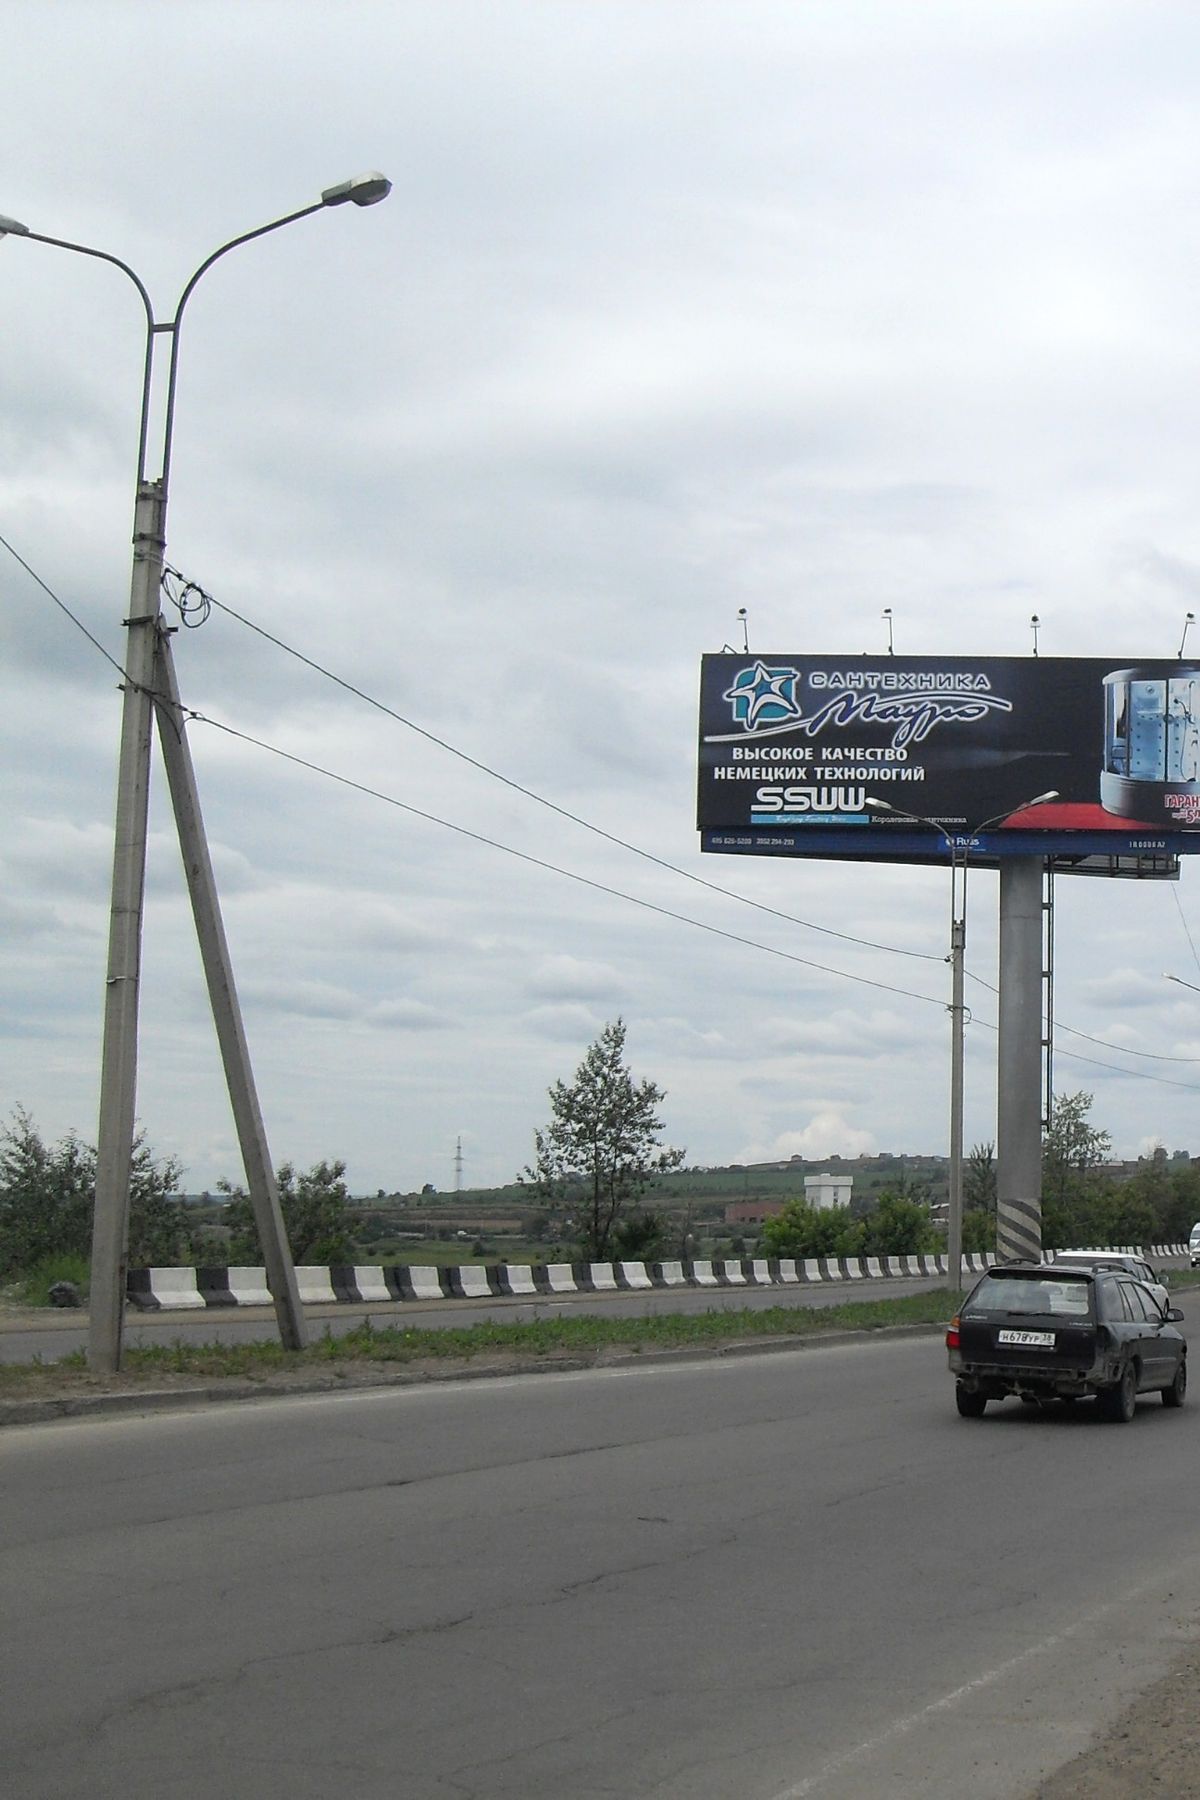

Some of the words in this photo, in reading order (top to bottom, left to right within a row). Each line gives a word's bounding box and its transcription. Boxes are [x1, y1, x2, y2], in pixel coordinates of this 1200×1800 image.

[809, 671, 991, 689] САНТЕХНИКА
[732, 747, 814, 761] ВЫСОКОЕ
[822, 748, 908, 762] КАЧЕСТВО
[713, 766, 808, 782] НЕМЕЦКИХ
[814, 766, 926, 782] ТЕХНОЛОГИЙ
[750, 786, 866, 812] SSWW
